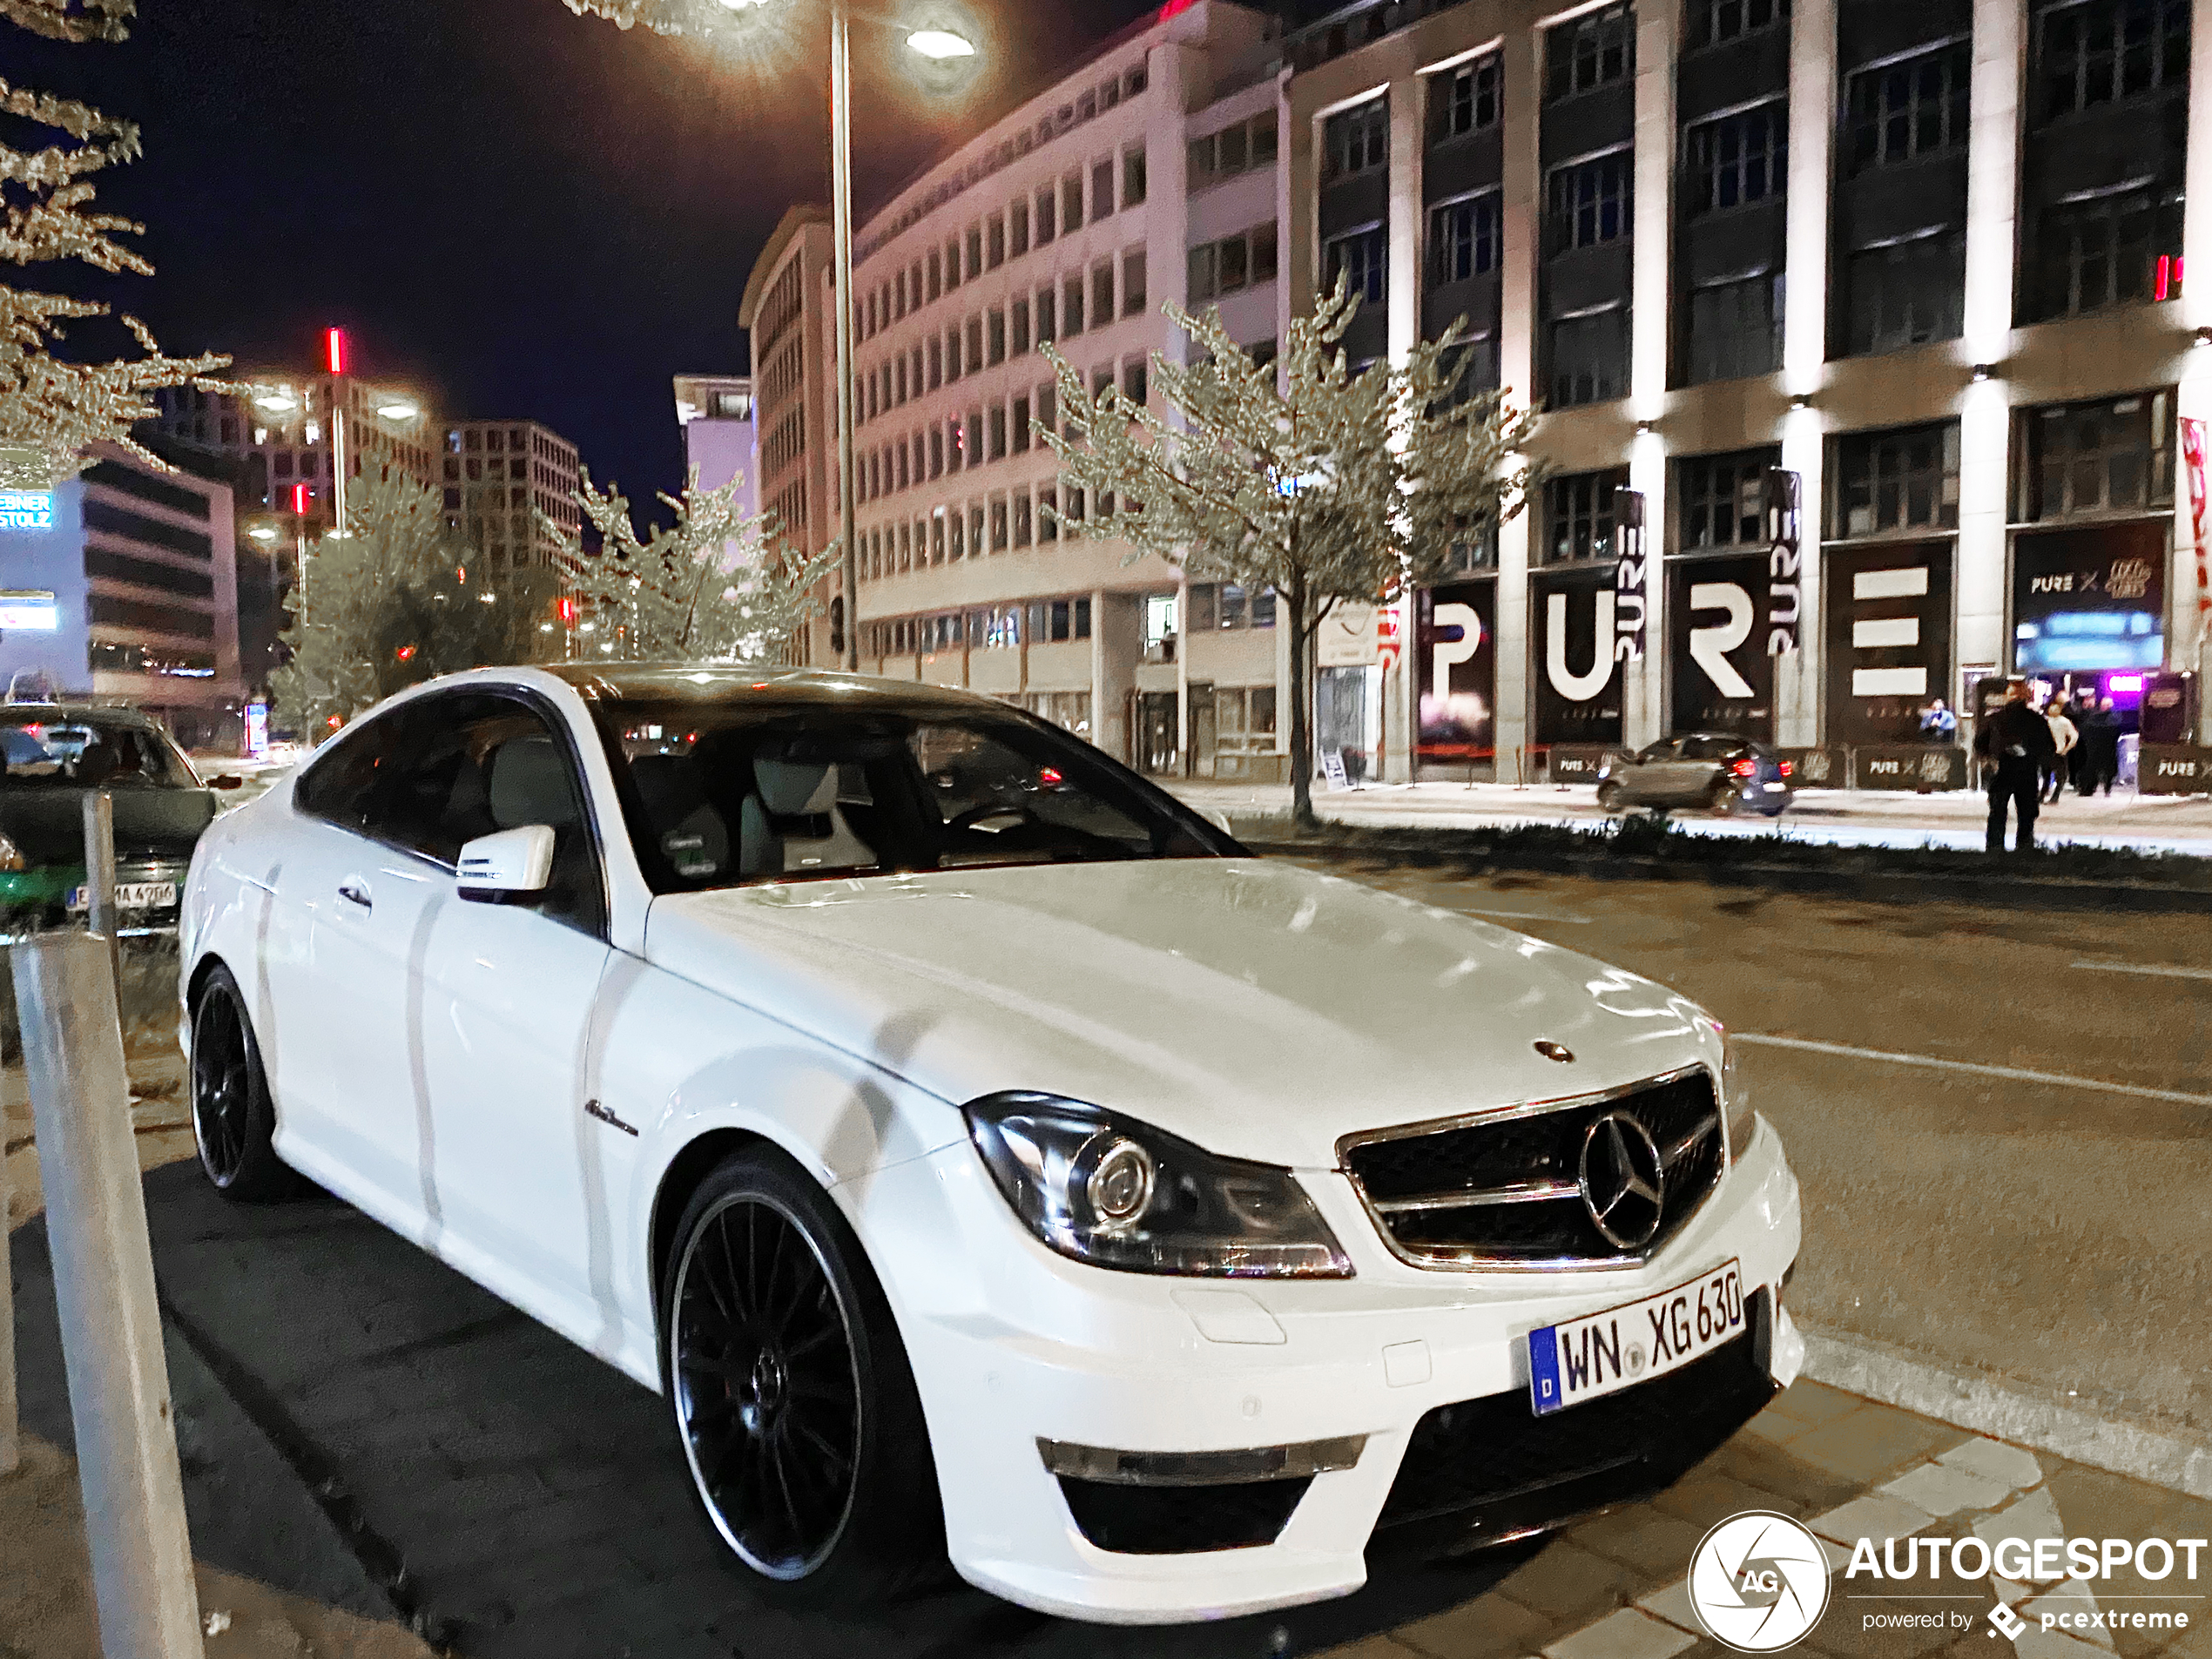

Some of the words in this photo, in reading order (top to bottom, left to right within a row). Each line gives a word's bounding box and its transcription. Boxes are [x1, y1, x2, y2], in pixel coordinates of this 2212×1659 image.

[2031, 572, 2074, 594] PURE
[1561, 1319, 1622, 1393] WN
[1648, 1297, 1692, 1367] XG
[1697, 1271, 1742, 1343] 630
[1541, 1379, 1553, 1398] D
